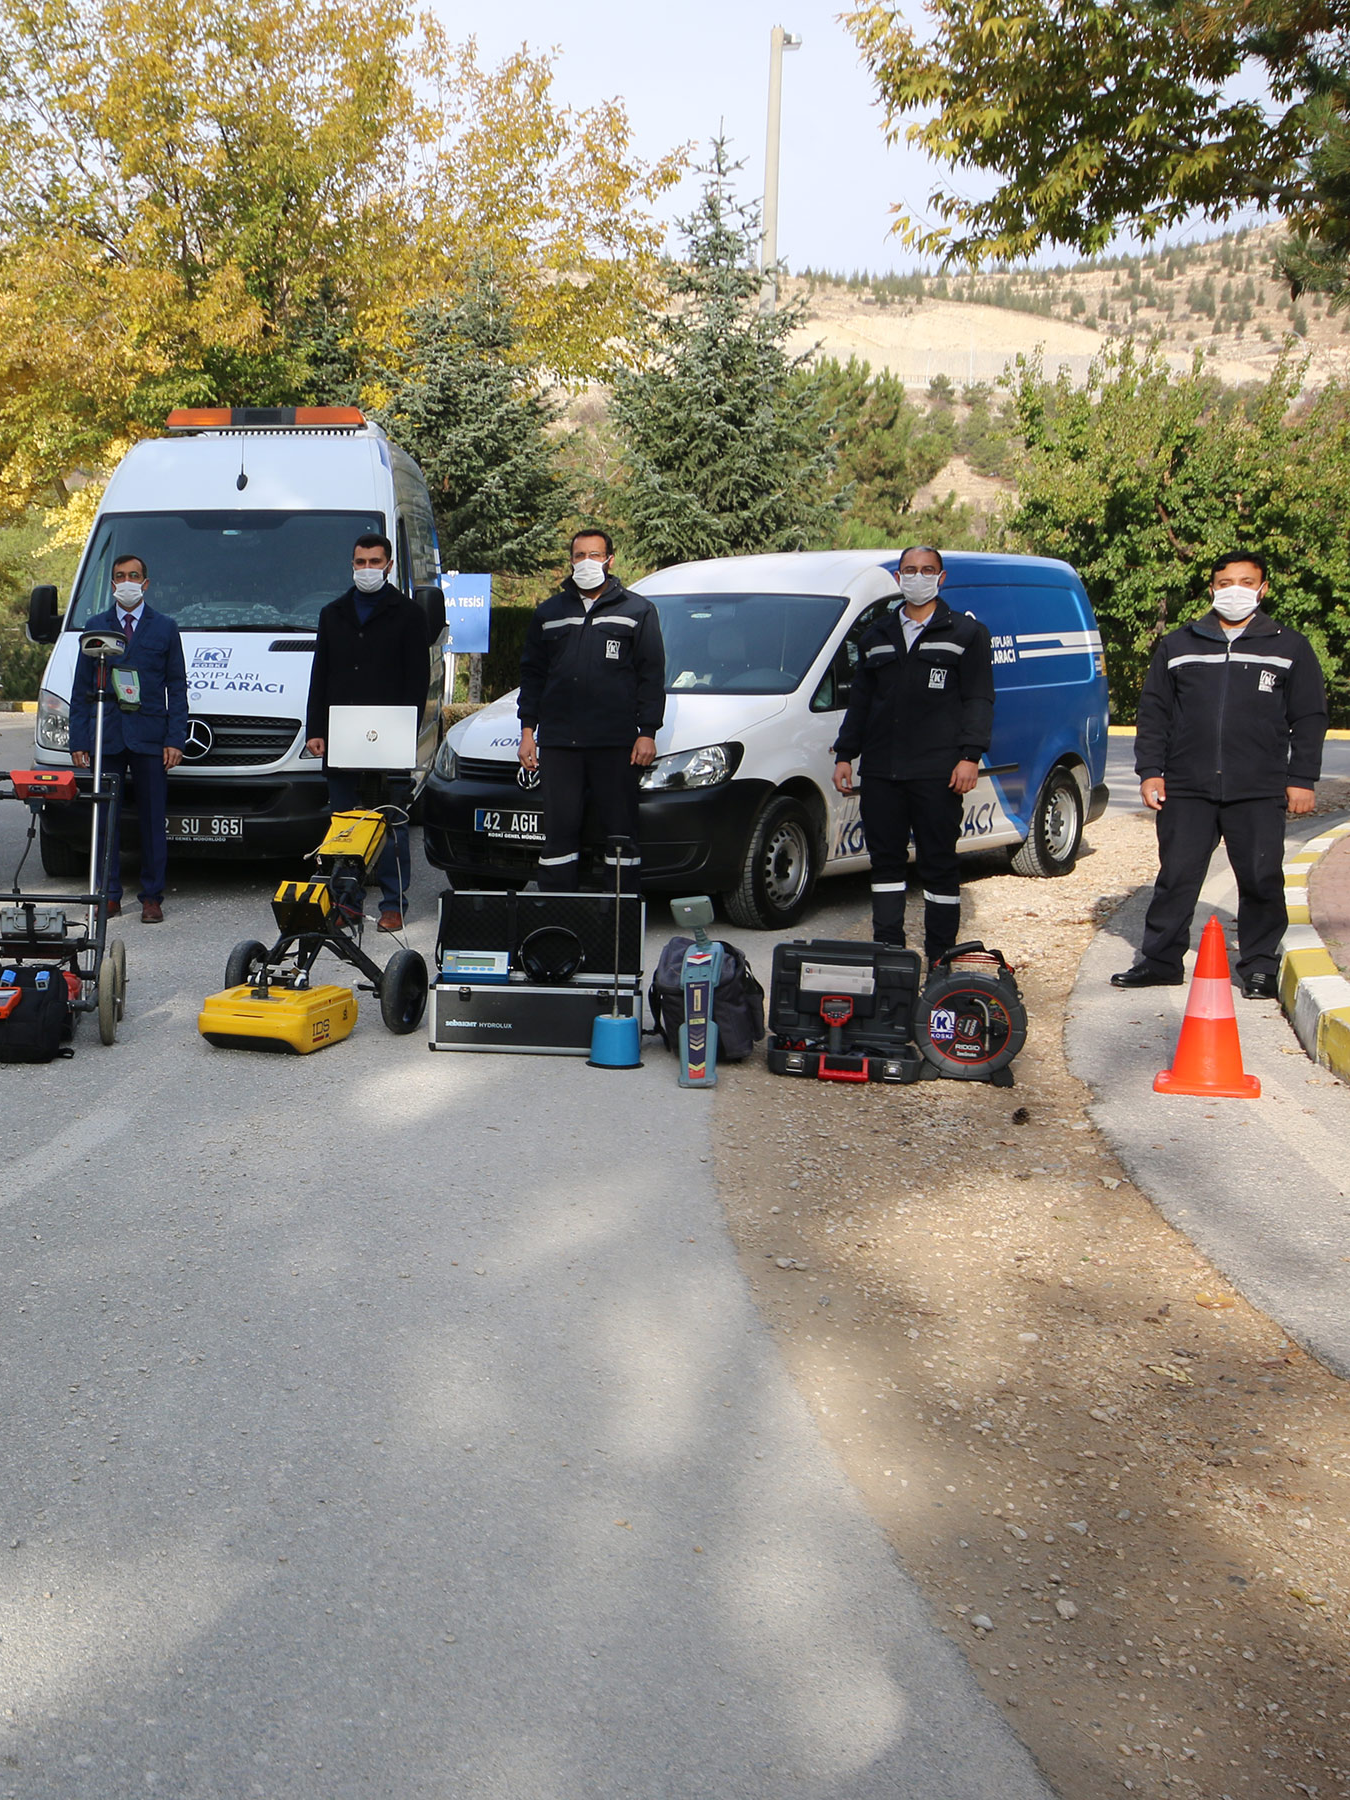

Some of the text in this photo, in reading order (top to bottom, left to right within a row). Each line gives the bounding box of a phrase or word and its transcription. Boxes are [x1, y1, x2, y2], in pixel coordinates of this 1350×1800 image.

[458, 595, 485, 608] TESİSİ
[224, 681, 285, 693] ARACI
[181, 818, 199, 834] SU
[211, 819, 239, 835] 965
[483, 812, 538, 832] 42 AGH
[312, 1019, 330, 1036] IDS
